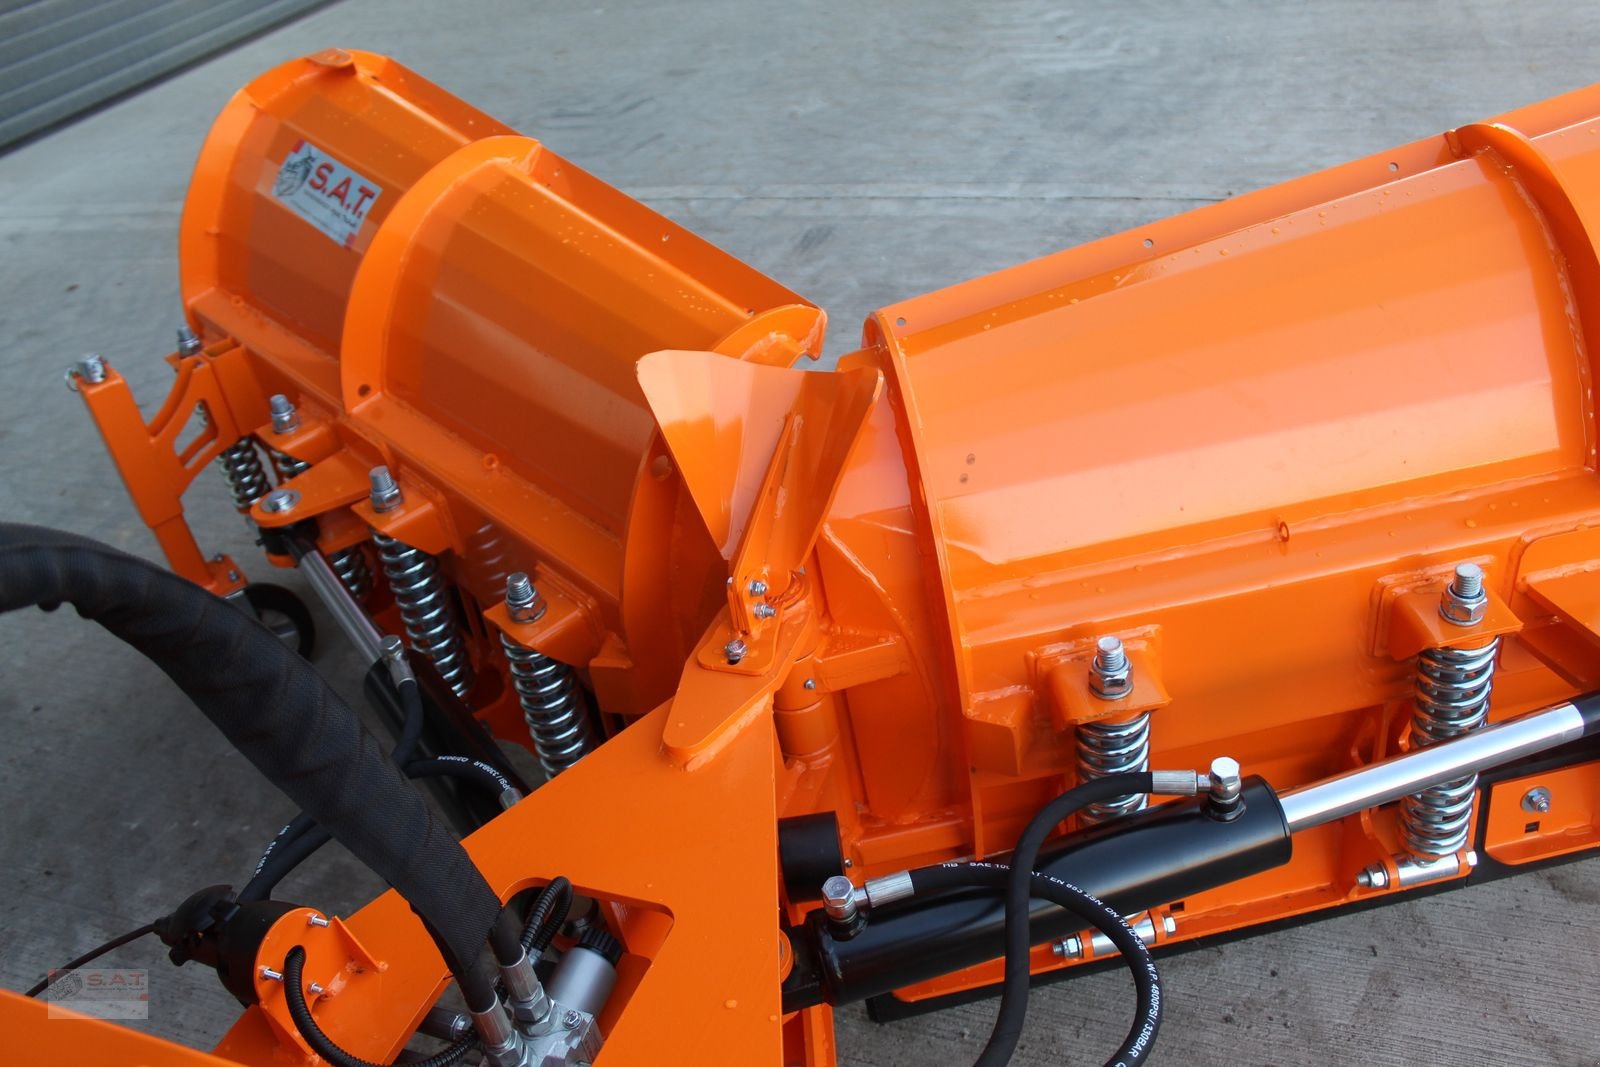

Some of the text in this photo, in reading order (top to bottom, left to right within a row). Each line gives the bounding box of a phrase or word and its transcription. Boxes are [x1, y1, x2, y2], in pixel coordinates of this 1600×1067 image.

[1049, 877, 1065, 885] EN
[1104, 907, 1120, 918] DN
[1119, 918, 1129, 927] 10
[1128, 1023, 1153, 1058] 330BAR
